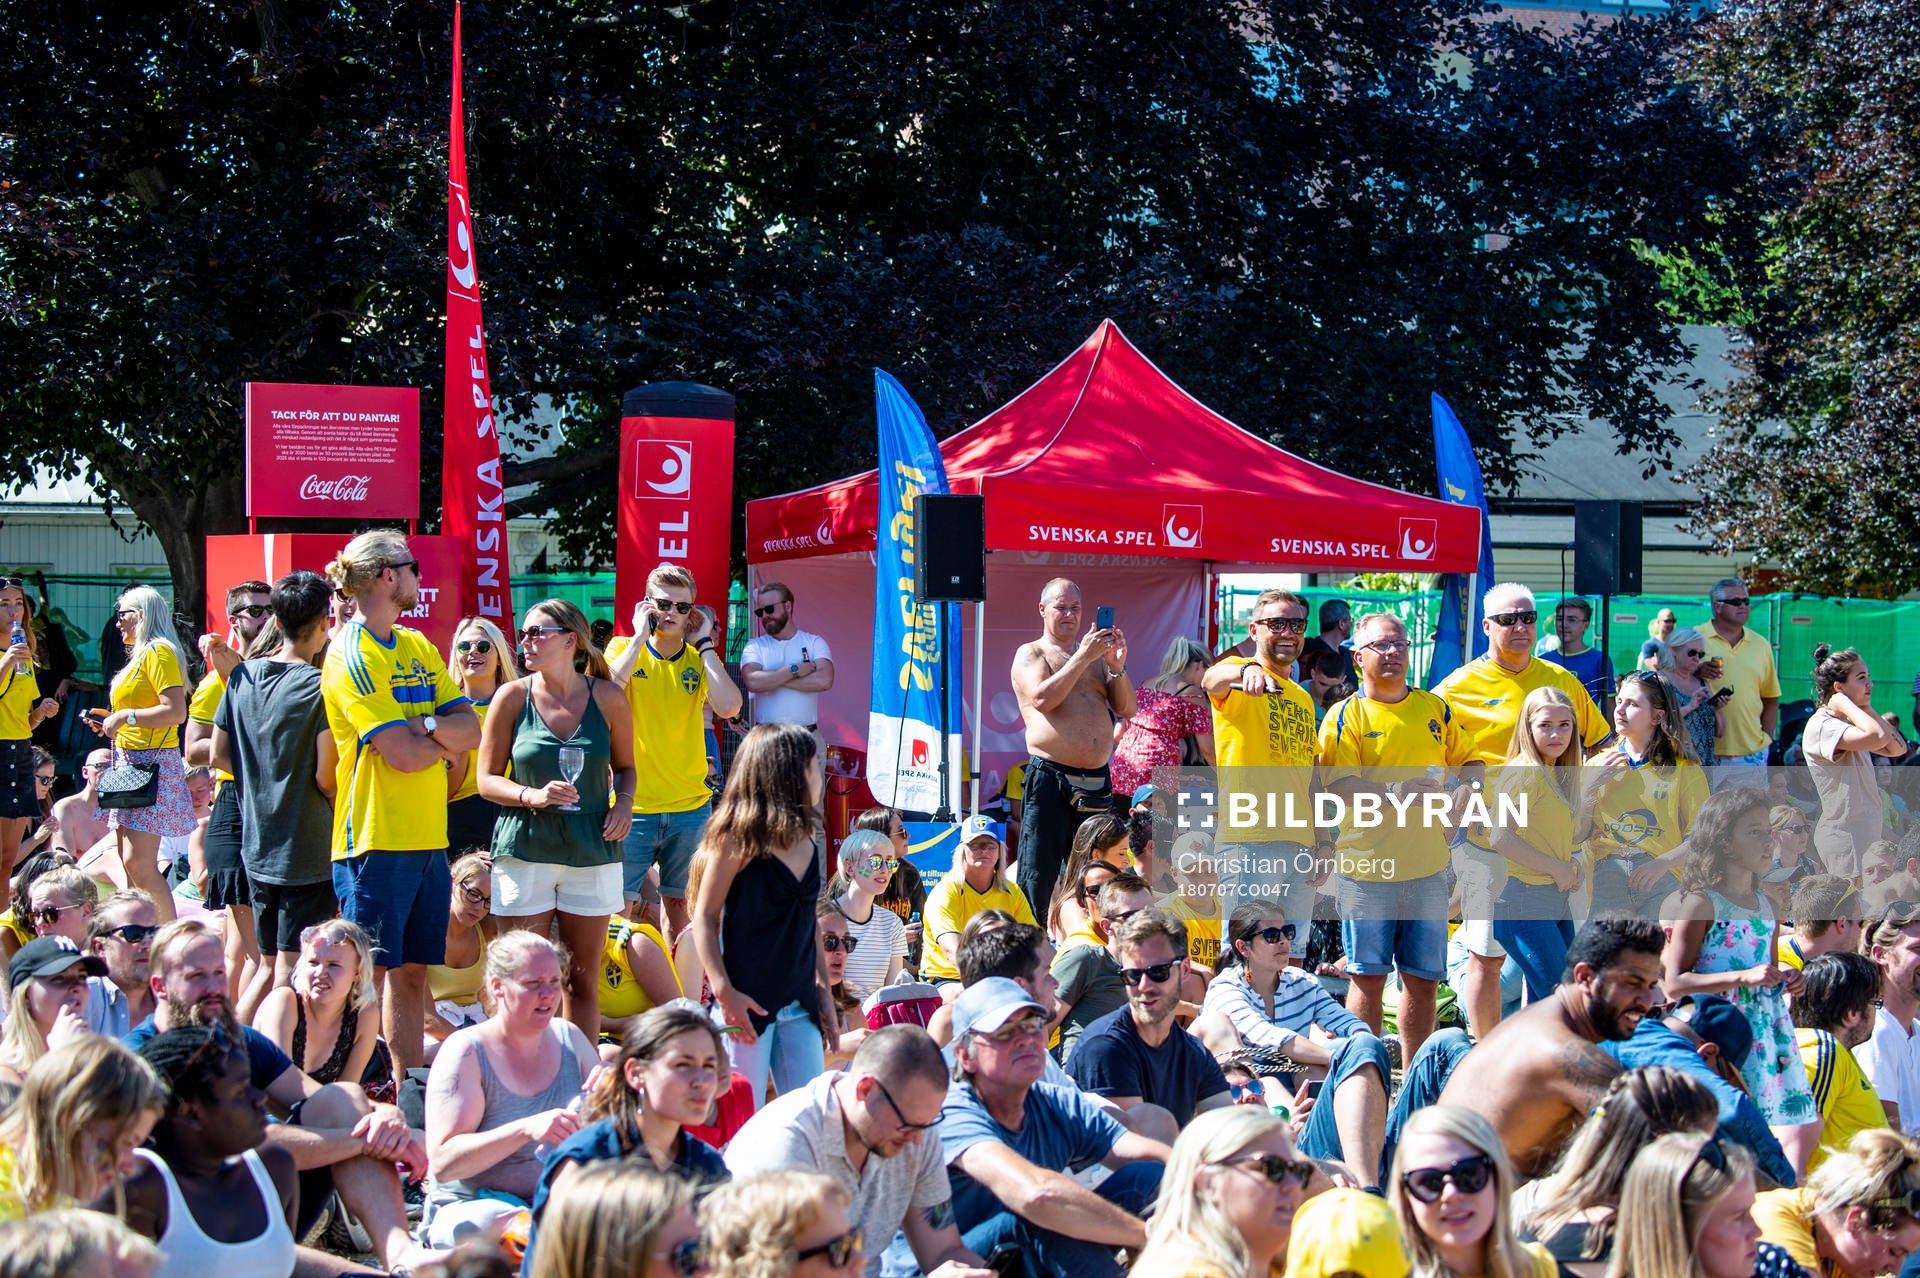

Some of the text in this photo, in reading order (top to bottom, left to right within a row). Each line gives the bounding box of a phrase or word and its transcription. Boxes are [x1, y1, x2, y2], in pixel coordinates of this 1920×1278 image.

[470, 324, 496, 439] SPEL
[272, 409, 400, 423] TACK FÖR ATT DU PANTAR!
[300, 474, 372, 501] Coca-Cola
[477, 457, 504, 617] ENSKA
[658, 511, 690, 567] EL
[763, 535, 818, 553] SVENSKA SPEL
[1028, 525, 1156, 546] SVENSKA SPEL
[1270, 538, 1390, 559] SVENSKA SPEL
[416, 588, 439, 602] TT
[400, 603, 430, 618] AR!
